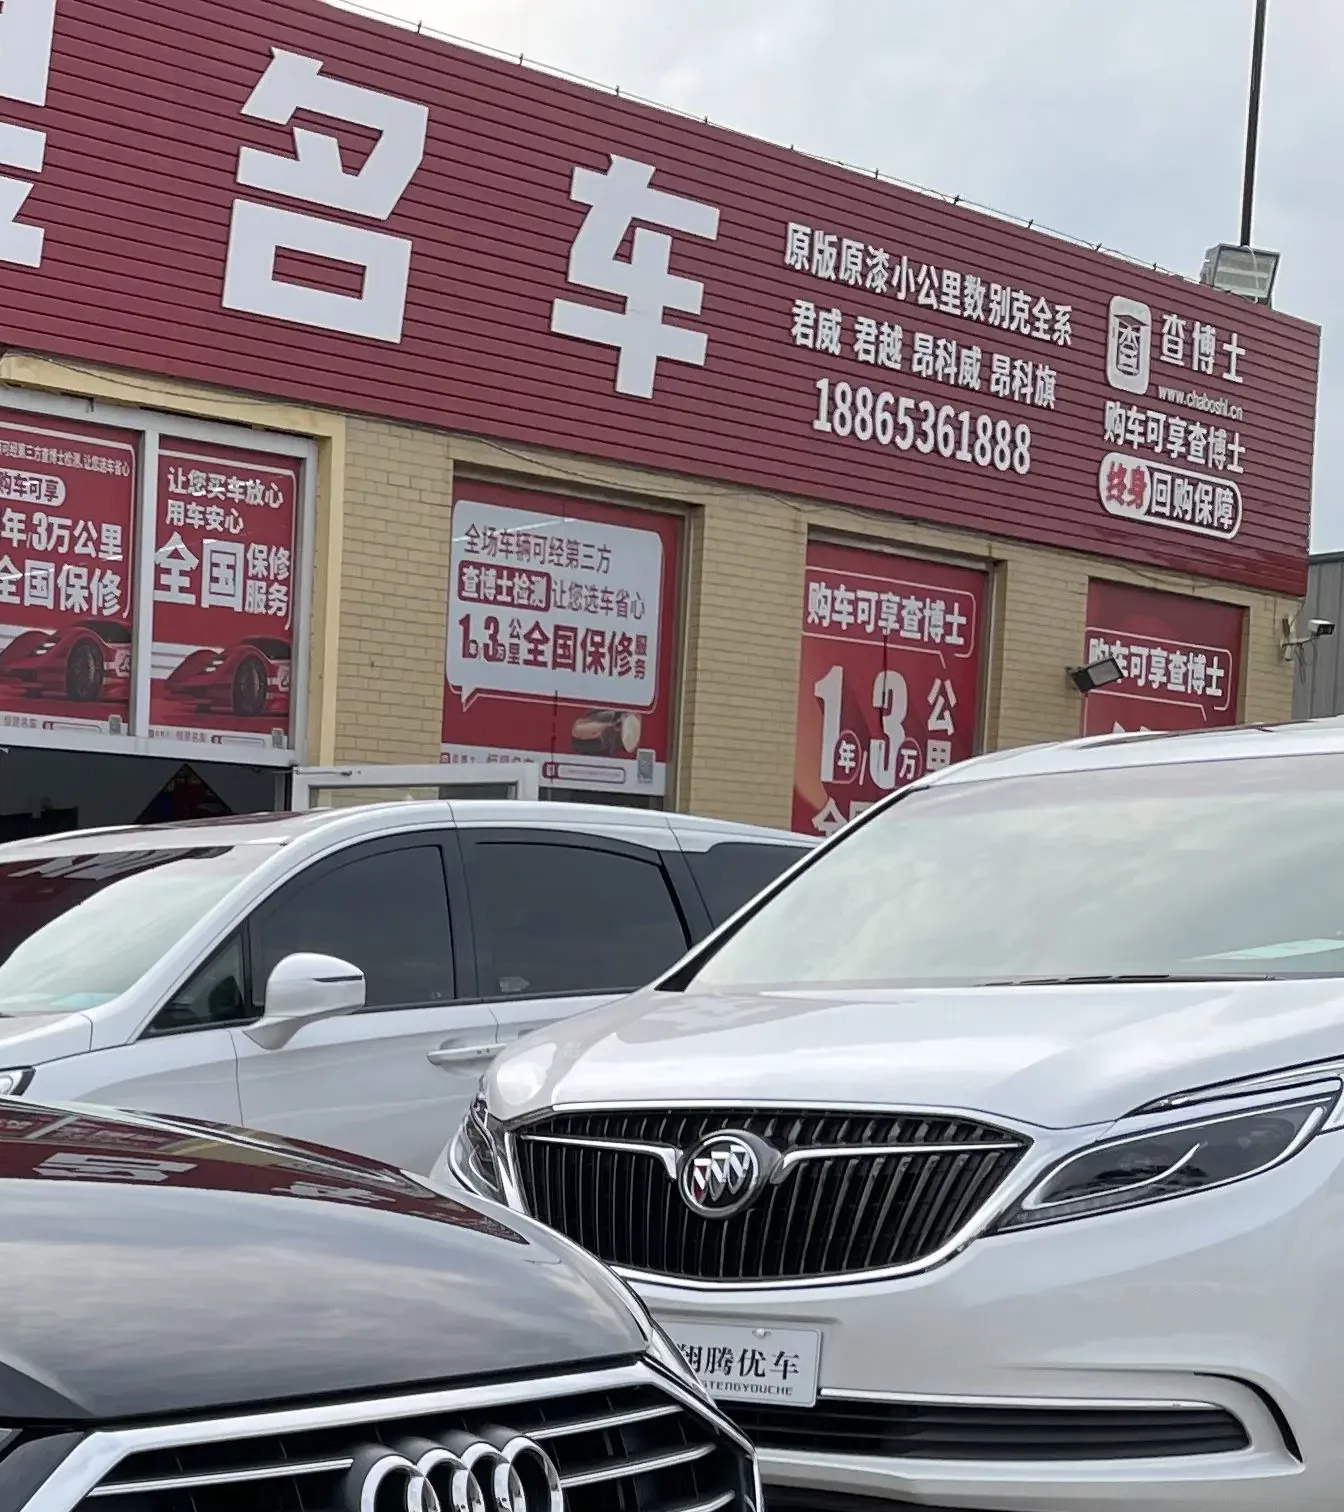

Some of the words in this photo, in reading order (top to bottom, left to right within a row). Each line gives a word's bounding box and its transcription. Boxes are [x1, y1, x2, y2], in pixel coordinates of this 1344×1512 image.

[784, 222, 1073, 346] 原版原漆小公里数别克全系
[791, 299, 843, 356] 君威
[853, 315, 904, 371] 君越
[911, 332, 982, 391] 昂科威
[989, 353, 1057, 409] 昂科旗
[1160, 313, 1247, 384] 查博士
[813, 377, 1031, 475] 18865361888
[1104, 400, 1246, 474] 购车可享查博士
[165, 500, 245, 535] 用车安心
[167, 466, 284, 508] 让您买车放心
[1150, 471, 1235, 530] 回购保障
[806, 581, 968, 646] 购车可享查博士
